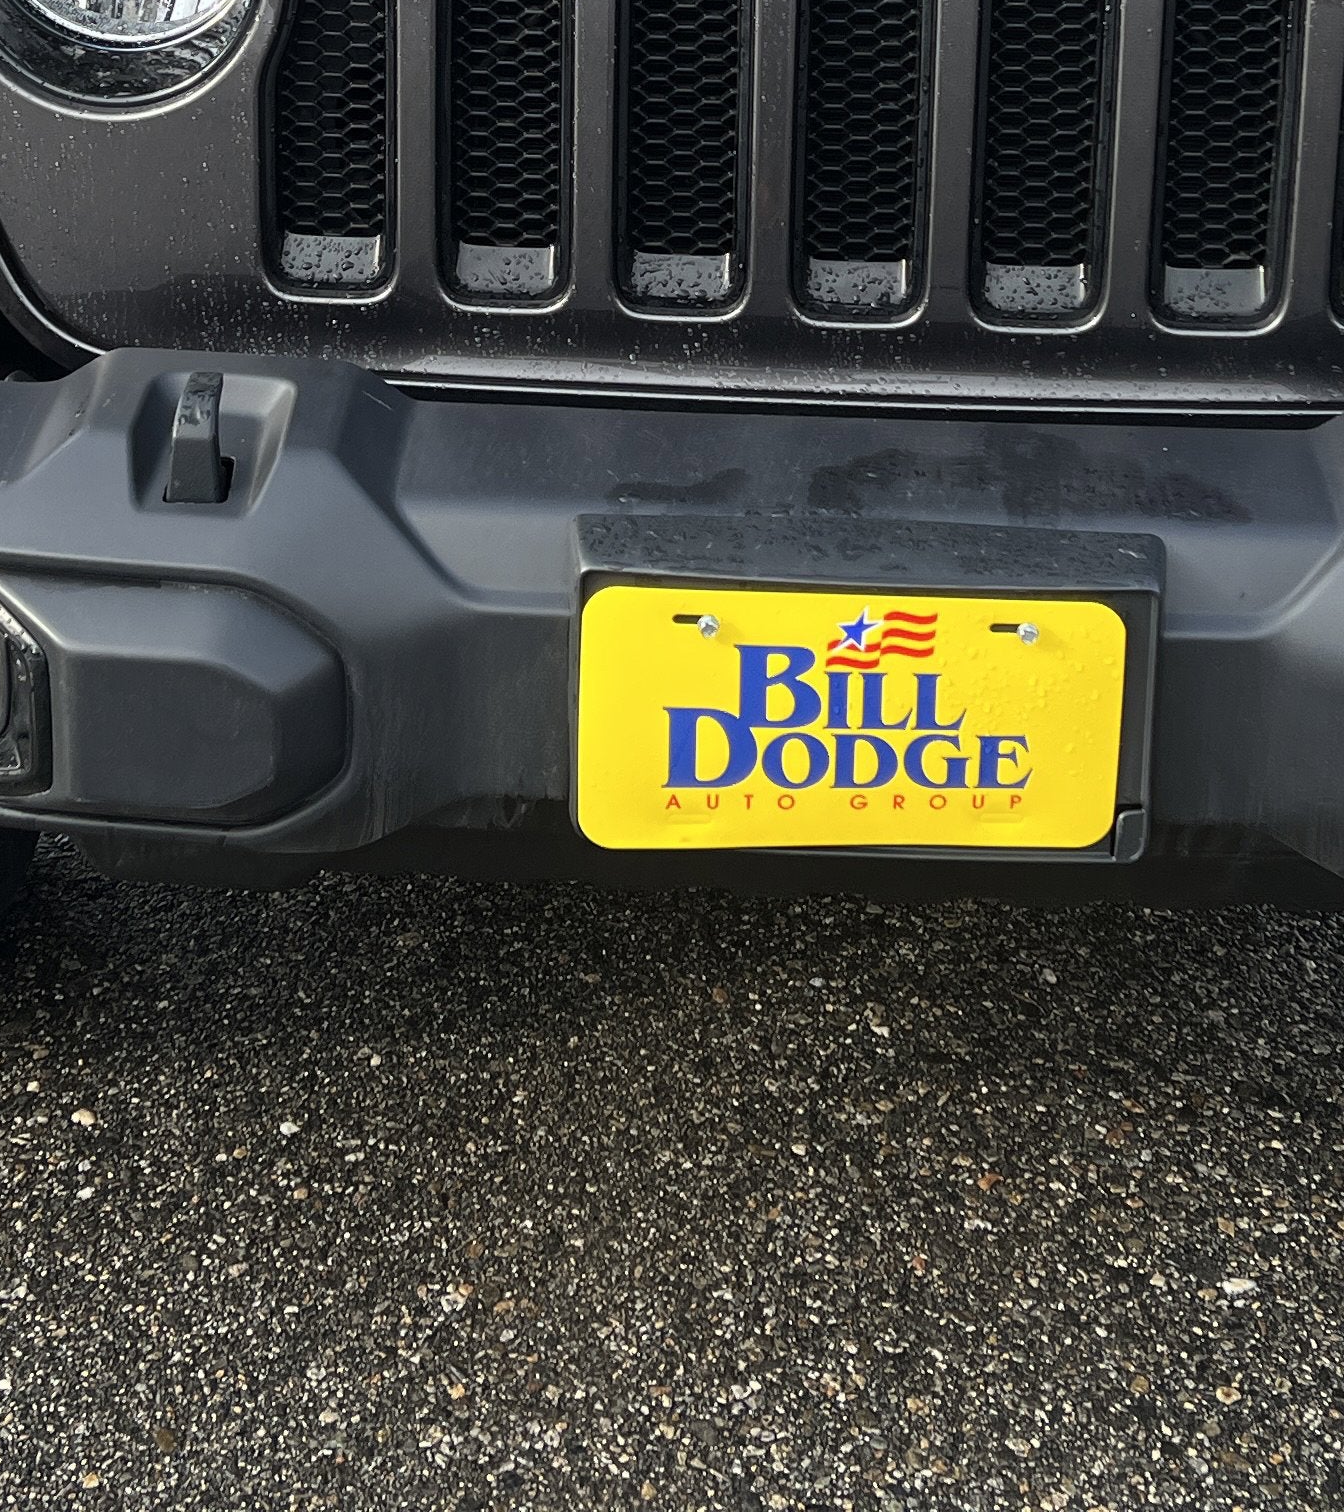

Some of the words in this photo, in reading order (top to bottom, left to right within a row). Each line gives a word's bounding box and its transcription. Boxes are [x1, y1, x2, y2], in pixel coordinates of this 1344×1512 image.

[734, 644, 966, 730] BILL
[661, 706, 1033, 789] DODGE
[665, 793, 796, 810] AUTO
[849, 794, 1023, 810] GROUP
